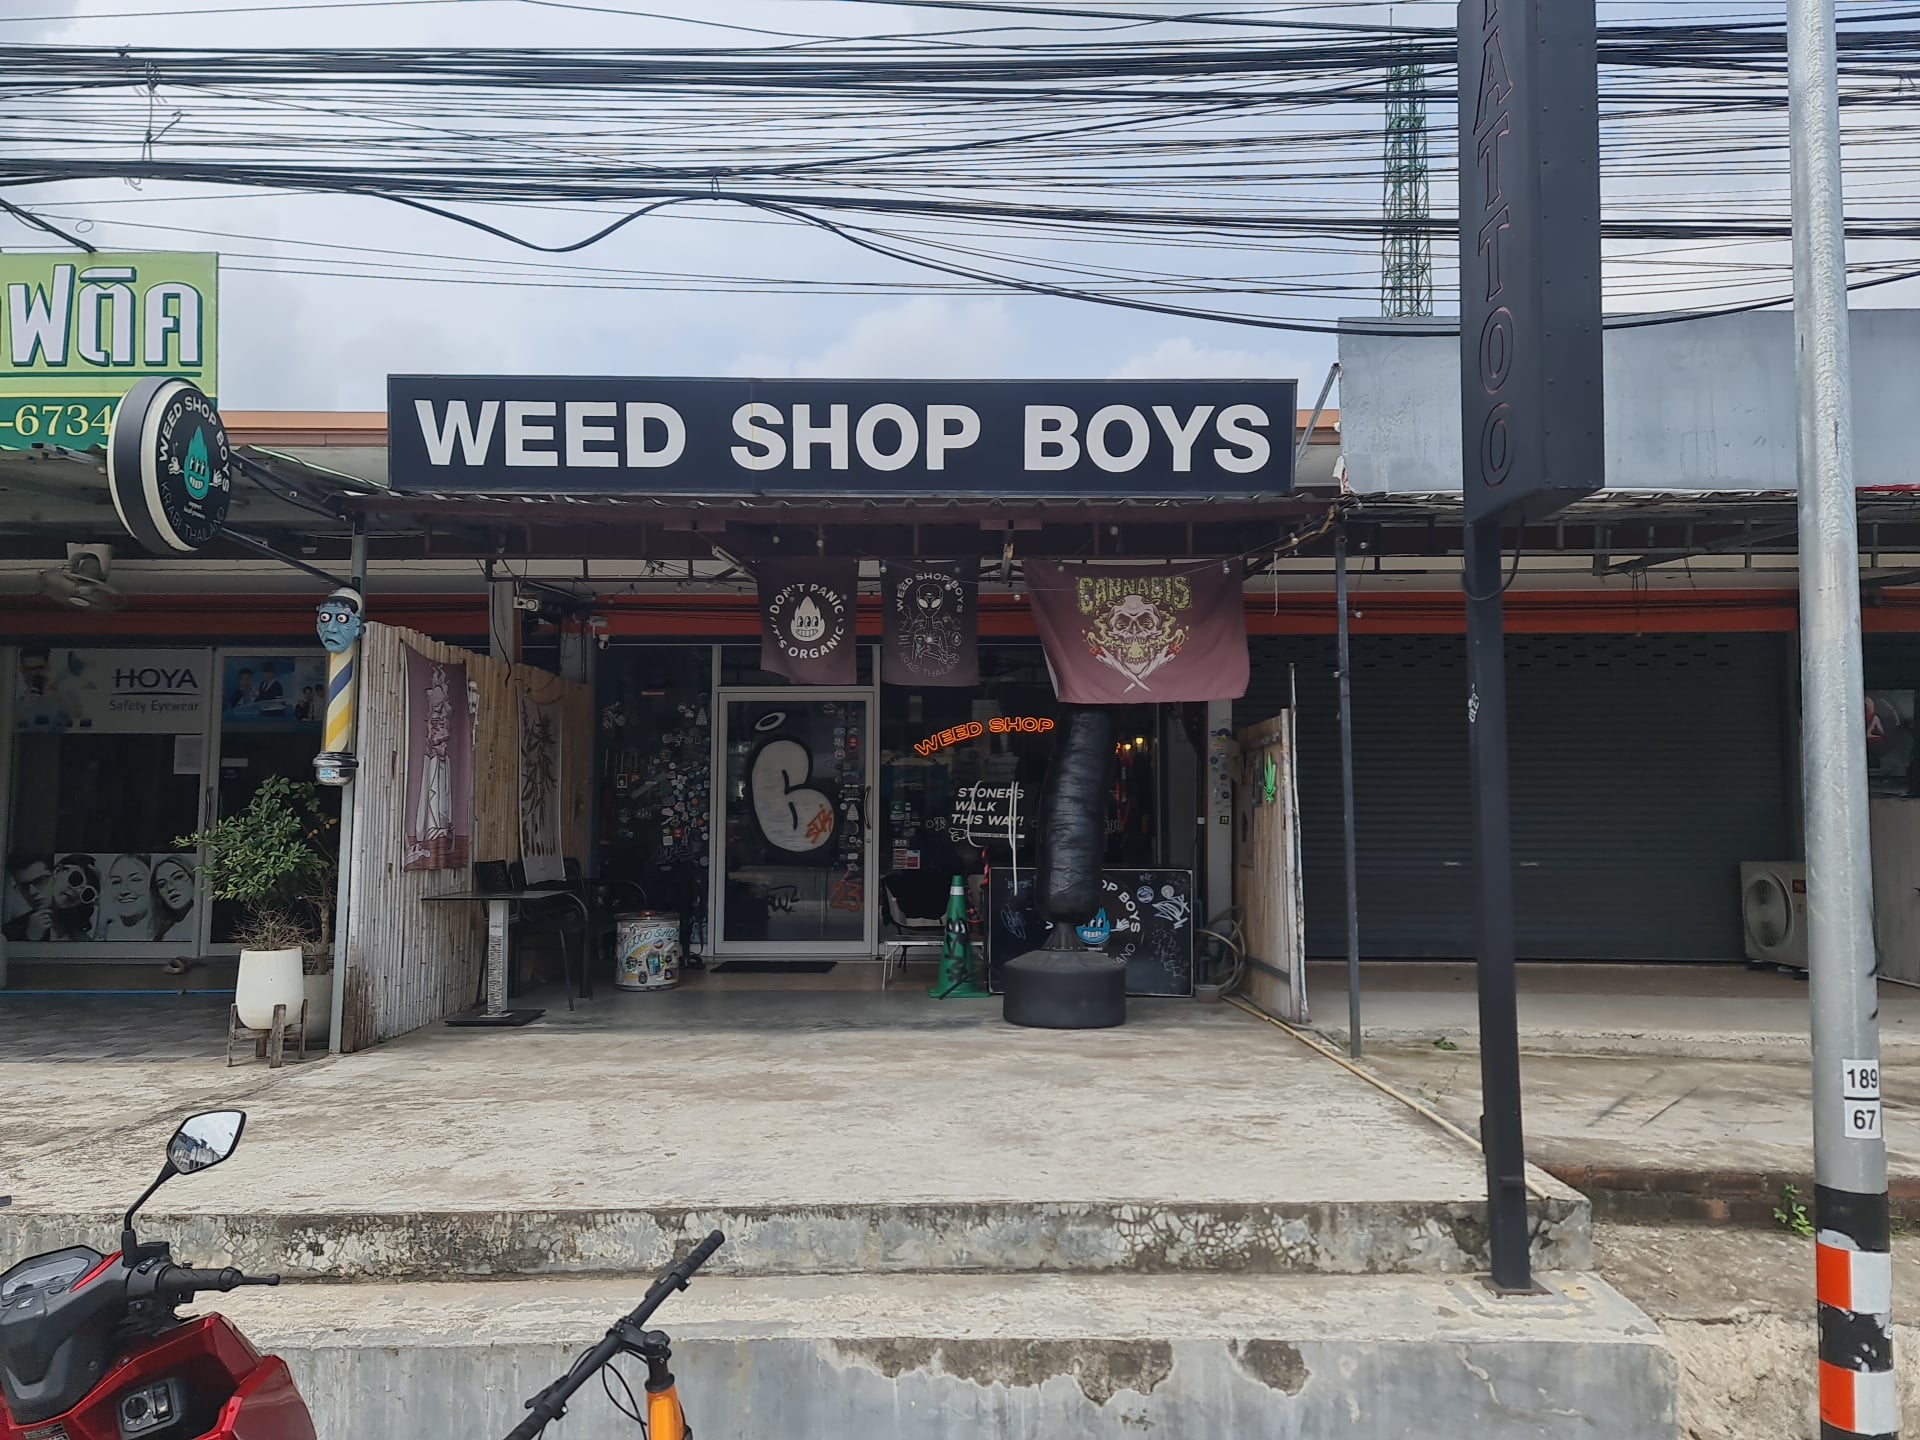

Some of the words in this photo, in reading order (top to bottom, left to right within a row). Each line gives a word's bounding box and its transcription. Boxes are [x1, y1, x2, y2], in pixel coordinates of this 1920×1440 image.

[158, 402, 183, 462] WEED
[184, 396, 217, 426] SHOP
[216, 429, 230, 493] BOYS
[413, 399, 687, 467] WEED
[730, 402, 981, 471] SHOP
[1024, 404, 1271, 473] BOYS
[160, 481, 182, 529] KRABI
[769, 583, 806, 615] DON'T
[810, 583, 845, 615] PANIC
[896, 577, 914, 611] WEED
[916, 572, 951, 582] SHOP
[950, 580, 964, 613] BOYS
[1078, 576, 1192, 615] CANNABIS
[788, 626, 845, 659] ORGANIC
[112, 668, 199, 689] HOYA
[108, 700, 147, 714] Safety
[151, 700, 199, 713] Eyewear
[913, 721, 983, 756] WEED
[988, 716, 1055, 733] SHOP
[955, 801, 998, 812] WALK
[957, 787, 1025, 799] STONERS
[951, 813, 985, 825] THIS
[1118, 891, 1141, 933] BOYS
[1846, 1068, 1878, 1088] 189
[1853, 1109, 1877, 1130] 67
